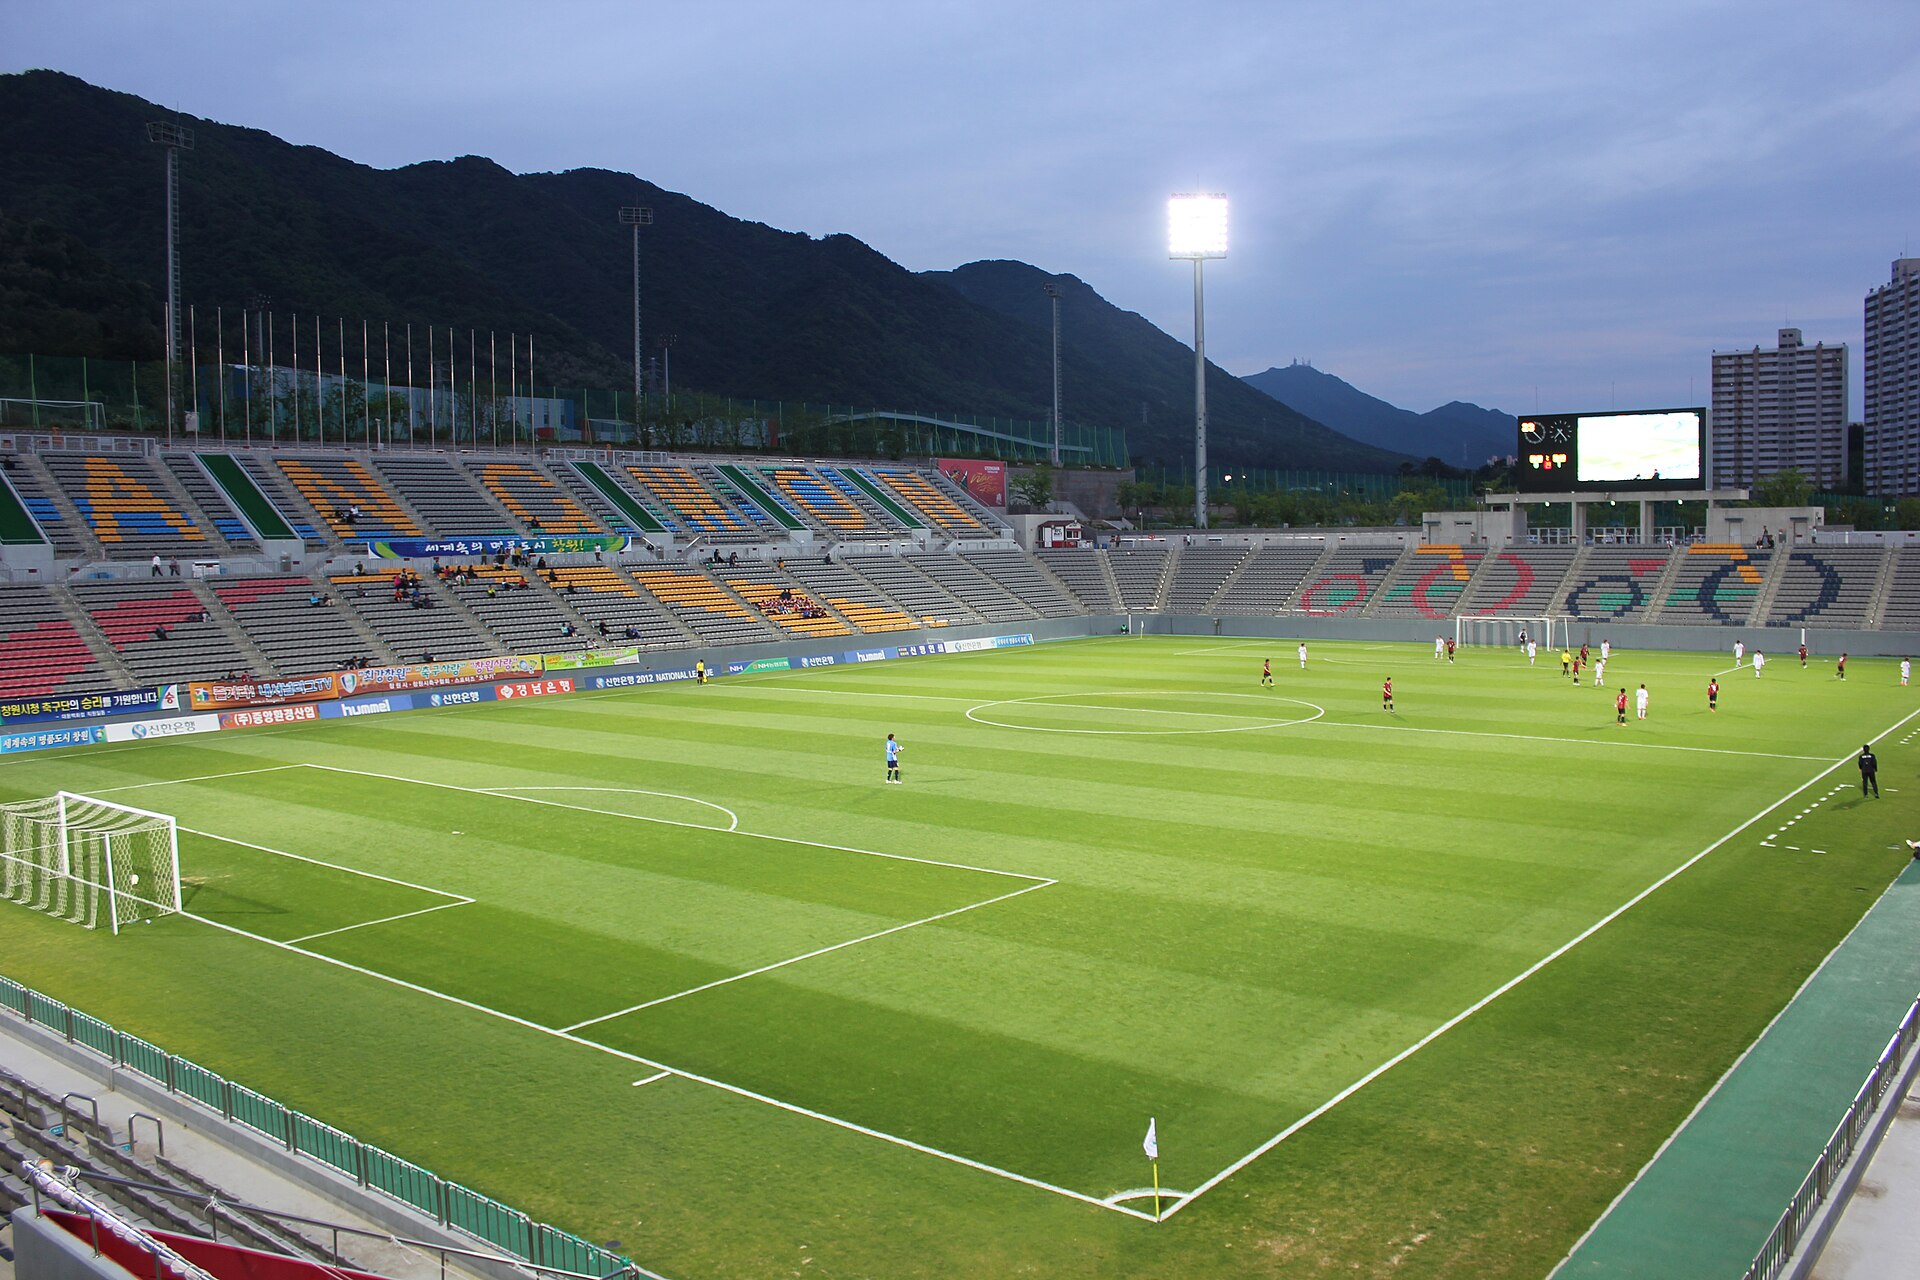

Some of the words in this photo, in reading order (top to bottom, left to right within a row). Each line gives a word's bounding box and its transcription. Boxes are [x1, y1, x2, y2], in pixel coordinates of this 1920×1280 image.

[425, 542, 483, 555] 세계속의
[552, 538, 584, 553] 창원!
[856, 649, 886, 663] hummel
[729, 662, 744, 673] NH
[636, 673, 655, 685] 2012
[655, 670, 688, 682] NATIONAL
[688, 668, 714, 680] LEUE
[516, 680, 571, 697] 경남은행
[165, 692, 176, 704] 승
[442, 691, 480, 706] 신한은행
[1, 702, 41, 718] 창원시청
[41, 699, 80, 713] 축구단의
[234, 705, 316, 726] (주)중앙환경산업
[340, 699, 392, 717] hummel
[148, 720, 196, 737] 신한은행
[3, 735, 37, 749] 세계속의
[38, 731, 71, 746] 명품도시
[72, 729, 90, 743] 창원
